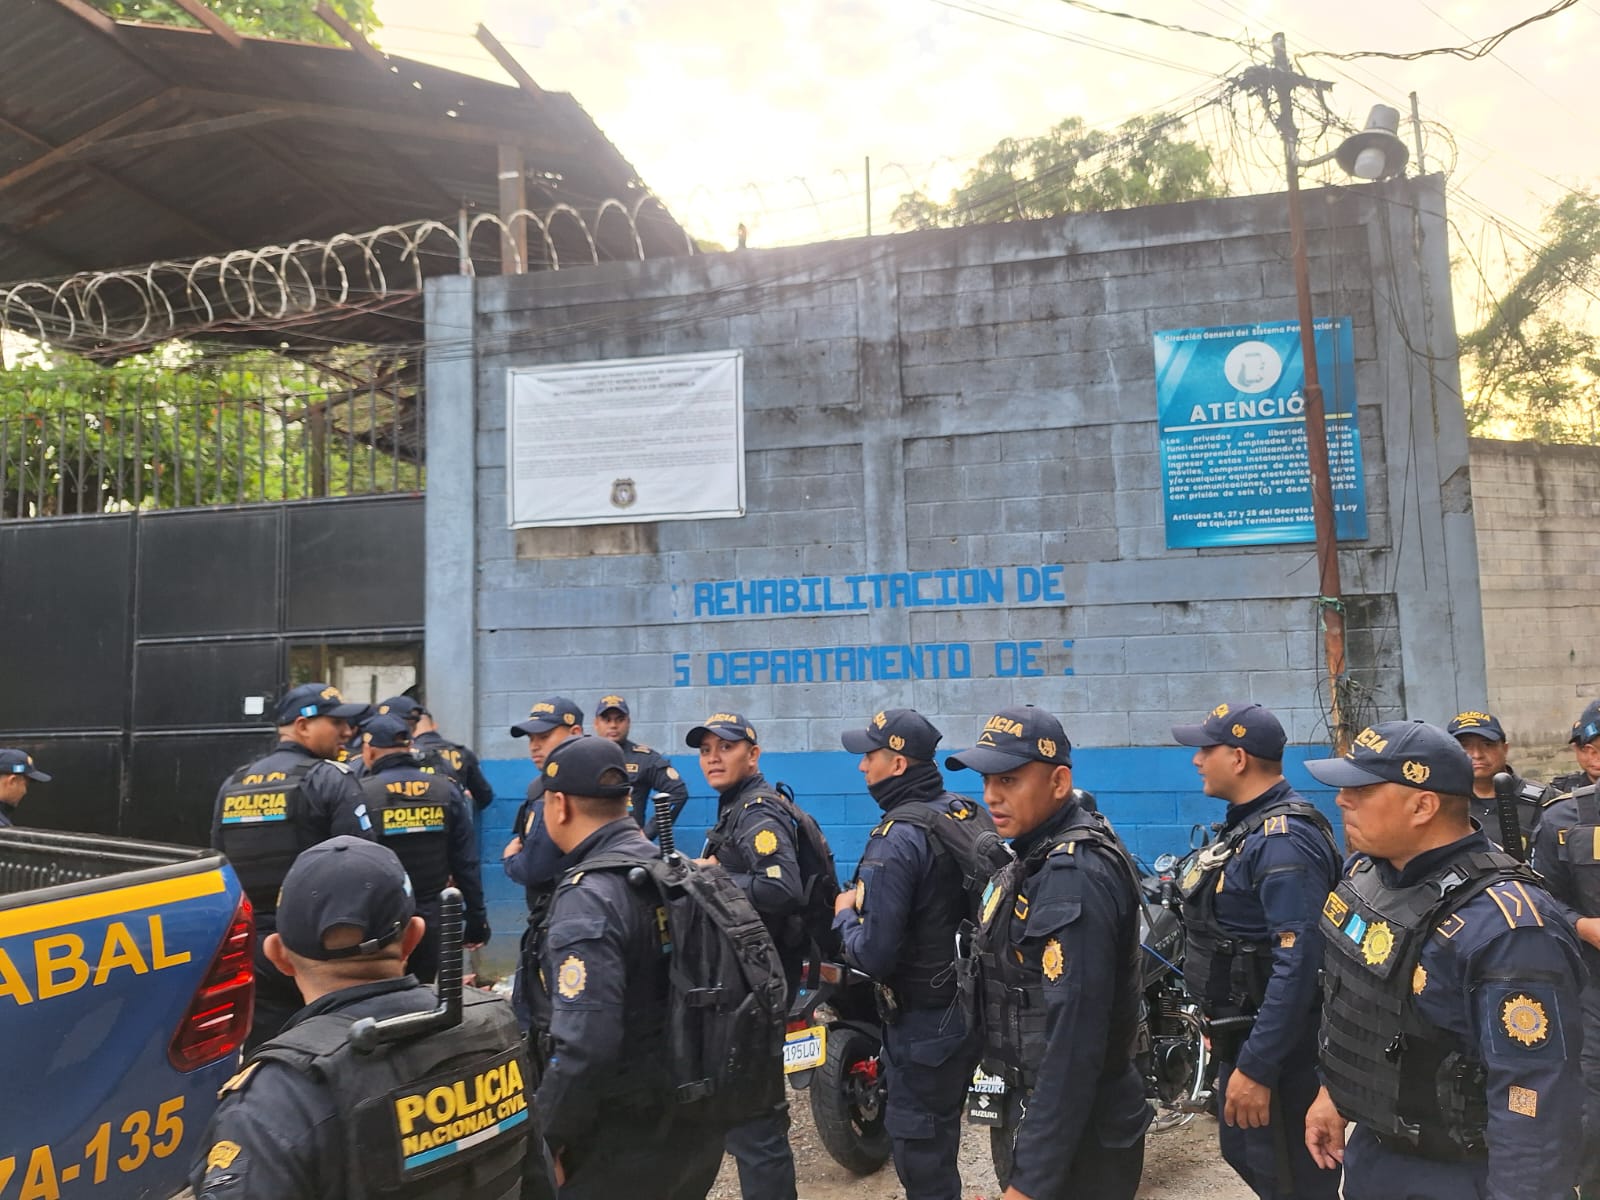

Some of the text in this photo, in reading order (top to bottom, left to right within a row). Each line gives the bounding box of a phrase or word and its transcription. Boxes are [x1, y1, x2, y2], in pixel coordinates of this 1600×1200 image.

[1203, 330, 1234, 340] General
[1236, 328, 1249, 337] del
[1252, 325, 1285, 336] Sistema
[1190, 391, 1306, 423] ATENCIÓ
[1193, 434, 1231, 444] privados
[1268, 428, 1305, 437] libertad,
[1166, 443, 1220, 452] funcionarios
[1226, 442, 1232, 450] y
[1238, 438, 1286, 448] empleados
[1190, 449, 1247, 459] sorprendidos
[1168, 460, 1203, 470] ingresar
[1168, 468, 1203, 476] móviles,
[1209, 464, 1268, 473] componentes
[1169, 476, 1183, 485] y/o
[1185, 475, 1226, 483] cualquier
[1228, 472, 1259, 481] equipo
[1261, 469, 1311, 478] electrónico
[1169, 486, 1189, 494] para
[1270, 477, 1296, 485] serán
[1189, 491, 1219, 501] prisión
[1237, 488, 1255, 496] seis
[1227, 510, 1237, 518] 27
[1259, 508, 1272, 516] del
[1274, 506, 1309, 515] Decreto
[1209, 519, 1243, 528] Equipos
[1246, 516, 1294, 525] Terminales
[694, 568, 1003, 617] REHABILITACION
[1017, 565, 1065, 602] DE
[707, 643, 972, 686] DEPARTAMENTO
[995, 641, 1043, 677] DE
[984, 715, 1024, 738] LICIA
[1357, 727, 1389, 754] ICIA
[224, 792, 287, 811] POLICIA
[383, 806, 445, 823] POLICIA
[395, 1059, 524, 1135] POLICIA
[971, 1109, 998, 1119] SUZUKI
[402, 1093, 528, 1157] NACIONAL CIVIL
